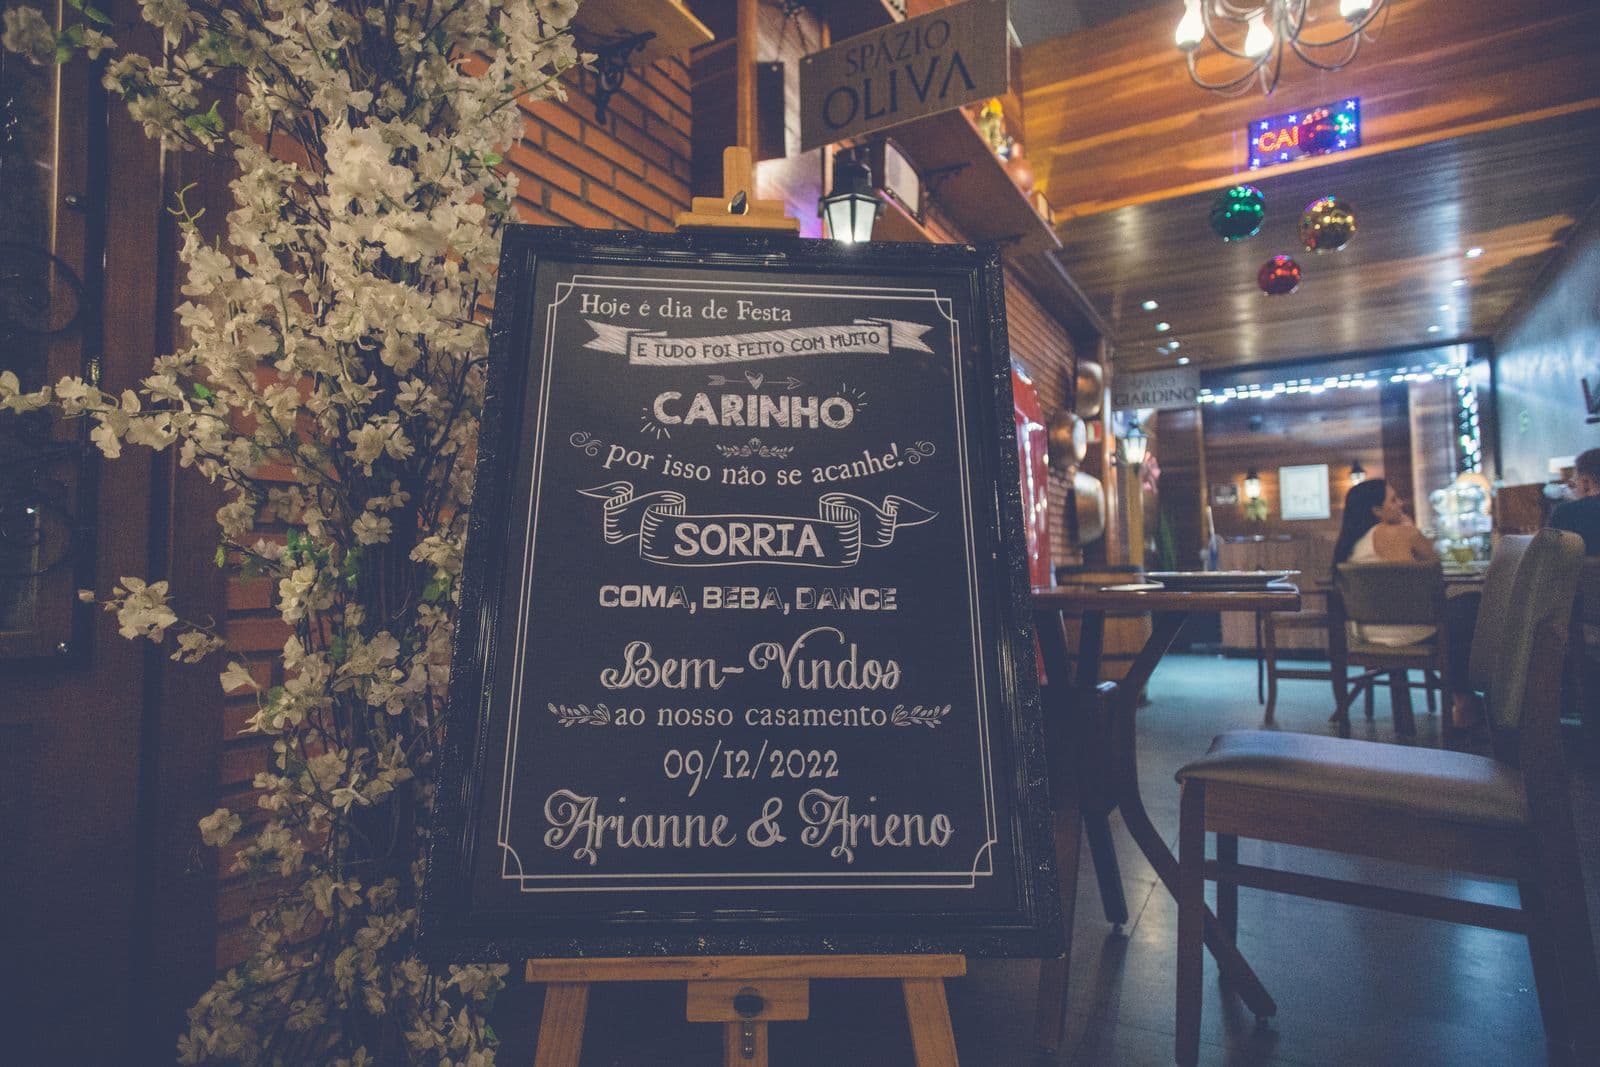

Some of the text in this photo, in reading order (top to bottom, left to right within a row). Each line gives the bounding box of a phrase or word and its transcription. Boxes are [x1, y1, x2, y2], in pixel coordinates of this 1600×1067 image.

[579, 293, 792, 322] Hoje é dia de Festa
[636, 331, 881, 358] E TUDO FOI FEITO COM MUITO
[653, 390, 855, 429] CARINHO
[603, 442, 905, 486] por isso não se acanhe!
[673, 522, 825, 558] SORRIA
[599, 585, 898, 615] COMA, BEBA, DANCE
[600, 626, 902, 690] Bem-Vindos
[614, 705, 888, 727] ao nosso casamento
[663, 739, 840, 797] 09/12/2022
[543, 788, 957, 865] Arianne & Arieno
